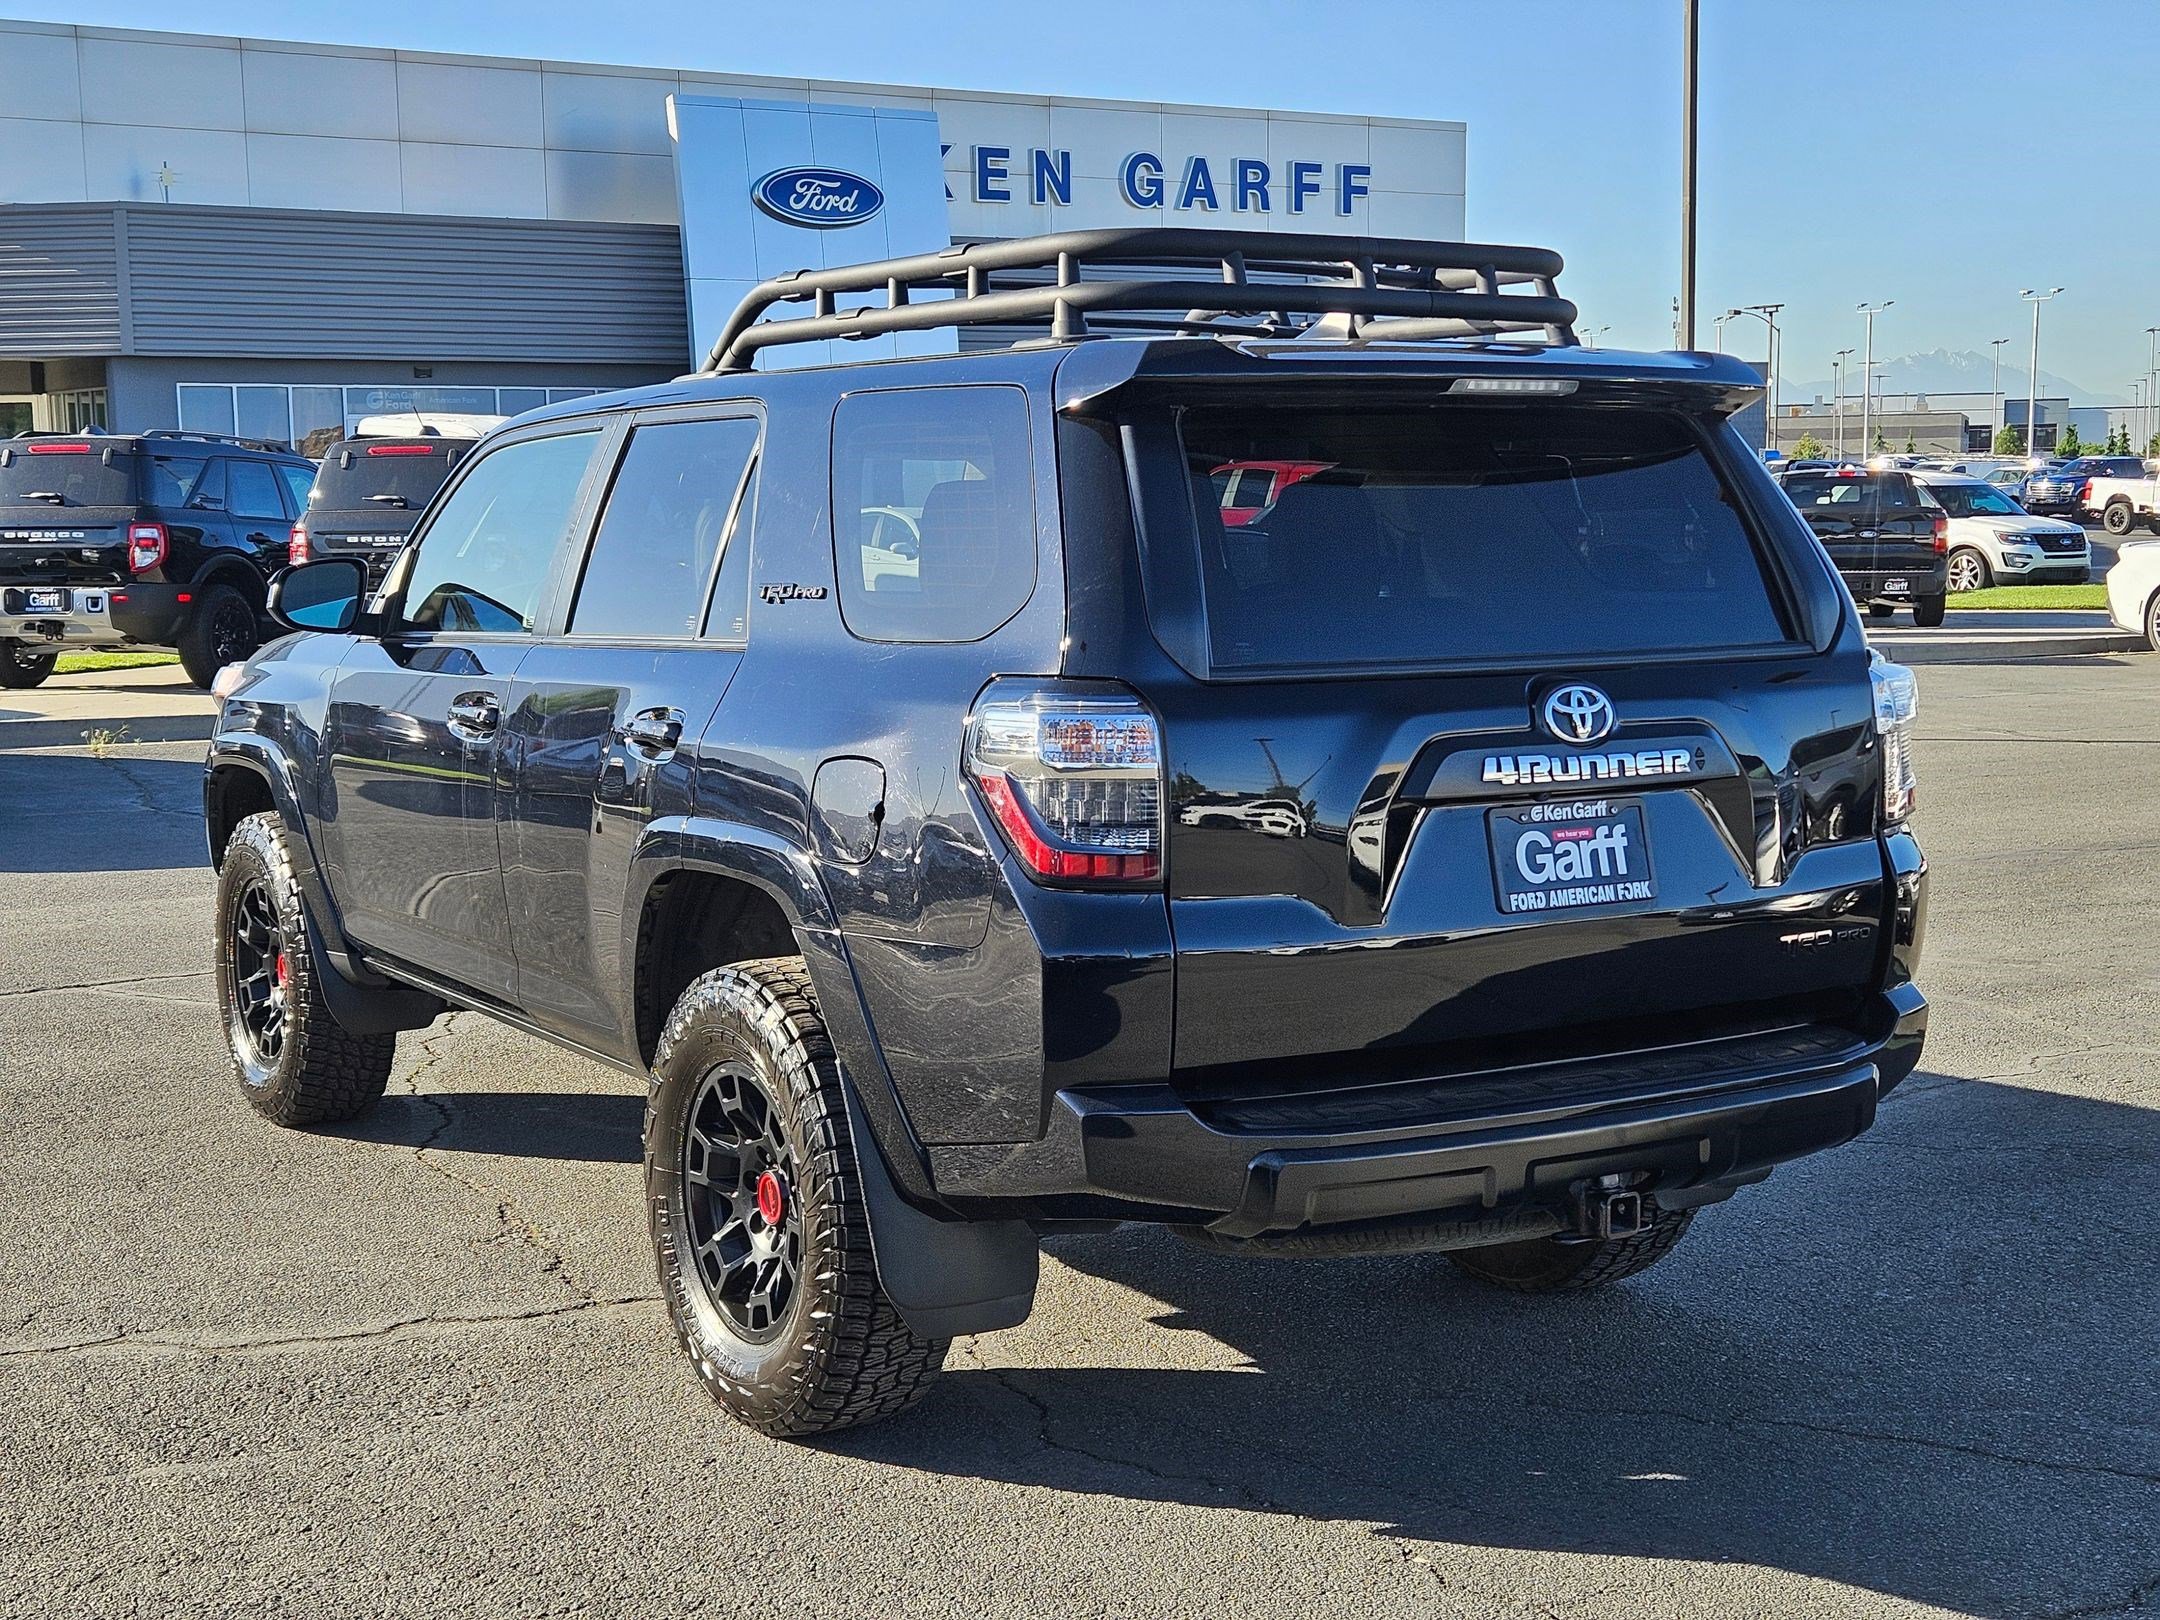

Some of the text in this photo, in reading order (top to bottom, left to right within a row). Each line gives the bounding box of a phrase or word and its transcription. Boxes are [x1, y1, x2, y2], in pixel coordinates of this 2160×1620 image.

[1119, 151, 1372, 217] GARFF
[789, 178, 859, 212] Ford
[793, 586, 827, 600] PRO
[1884, 581, 1908, 591] Garff
[29, 593, 60, 606] Garff
[1543, 804, 1572, 822] Ken
[1573, 800, 1608, 819] Garff
[1566, 830, 1578, 838] hear
[1578, 829, 1590, 839] you
[1516, 824, 1629, 884] Garff
[1509, 892, 1546, 912] FORD
[1550, 884, 1616, 908] AMERICAN
[1836, 926, 1871, 943] PRO
